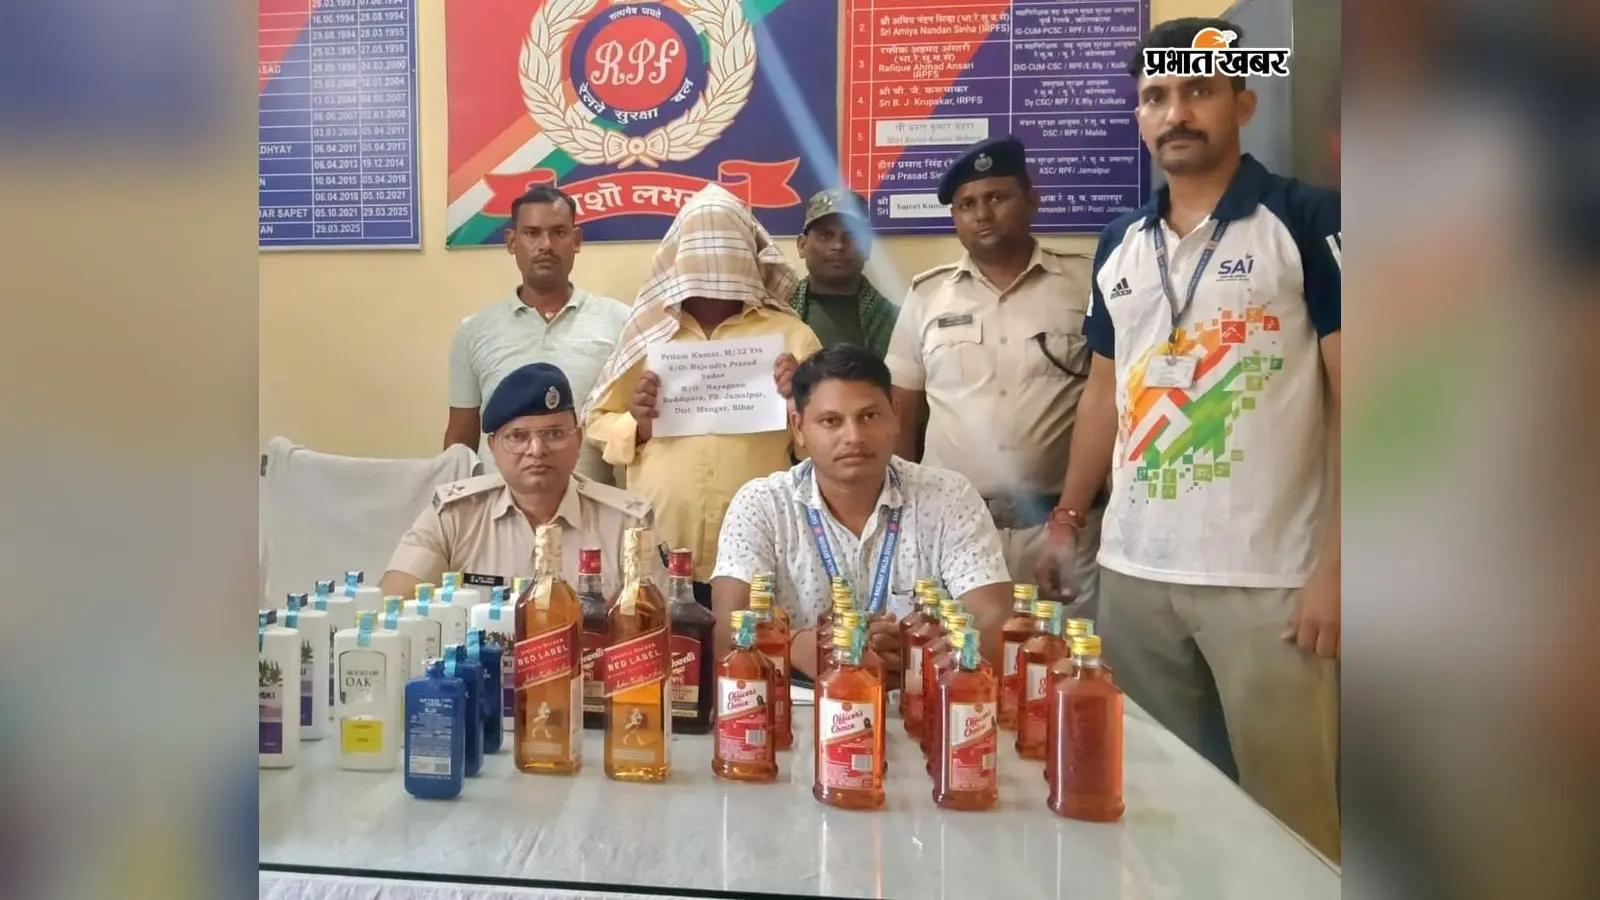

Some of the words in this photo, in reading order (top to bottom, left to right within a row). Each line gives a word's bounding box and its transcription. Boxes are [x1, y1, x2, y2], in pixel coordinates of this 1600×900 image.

[609, 6, 638, 21] सत्यमेव
[642, 7, 662, 20] जयते
[893, 27, 918, 37] Amiya
[920, 26, 951, 35] Nandan
[954, 25, 977, 34] Sinha
[879, 63, 911, 73] Rafique
[947, 61, 974, 70] Ansari
[579, 81, 607, 114] रेलवे
[615, 108, 659, 124] सुरक्षा
[671, 78, 694, 103] बल
[879, 98, 892, 107] Sri
[956, 95, 983, 105] IRPFS
[877, 172, 895, 181] Hira
[897, 171, 928, 181] Prasad
[278, 208, 308, 218] SAPET
[316, 207, 358, 217] 05.10.2021
[316, 224, 360, 233] 29.03.2025
[1218, 257, 1254, 275] SAI
[661, 352, 689, 361] Pritam
[729, 359, 757, 368] Prasad
[732, 404, 755, 412] Bihar
[518, 655, 537, 667] RED
[538, 645, 569, 660] LABEL
[607, 660, 628, 672] RED
[628, 649, 662, 665] LABEL
[346, 677, 372, 688] OAK
